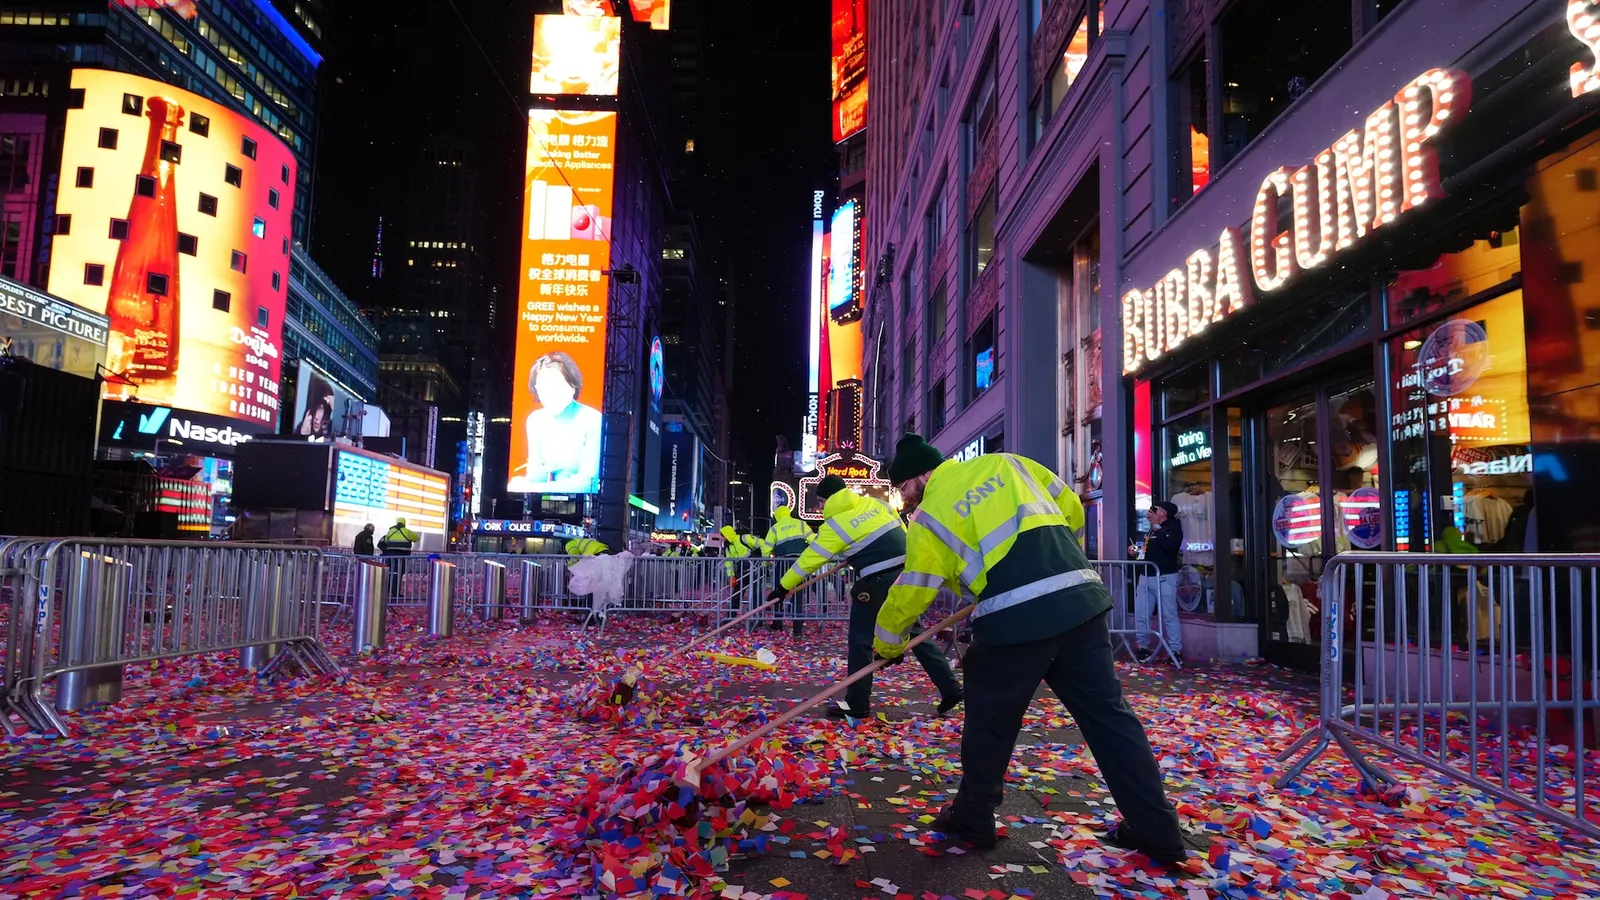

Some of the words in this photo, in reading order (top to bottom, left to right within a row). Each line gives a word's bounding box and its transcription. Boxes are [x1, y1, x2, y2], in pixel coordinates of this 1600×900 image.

[573, 150, 601, 159] Better
[564, 161, 612, 170] Appliances
[1122, 227, 1245, 376] BUBBA
[1251, 68, 1470, 291] GUMP
[0, 292, 36, 318] BEST
[526, 301, 556, 311] GREE
[556, 302, 592, 312] wishes
[592, 304, 600, 313] a
[522, 311, 554, 323] Happy
[555, 312, 579, 322] New
[579, 312, 604, 323] Year
[528, 322, 540, 332] to
[540, 323, 596, 333] consumers
[535, 332, 590, 343] worldwide.
[229, 365, 255, 384] NEW
[229, 399, 271, 423] RAISING
[964, 435, 987, 461] BELL
[1177, 431, 1204, 448] Dining
[1170, 450, 1188, 467] with
[1189, 452, 1196, 462] a
[670, 444, 678, 501] NOVEMBER
[827, 466, 848, 476] Hard
[847, 467, 868, 478] Rock
[952, 473, 1006, 519] DSNY
[480, 519, 502, 532] YORK
[503, 519, 532, 532] POLICE
[533, 519, 556, 533] DEPT
[849, 508, 880, 529] DSNY
